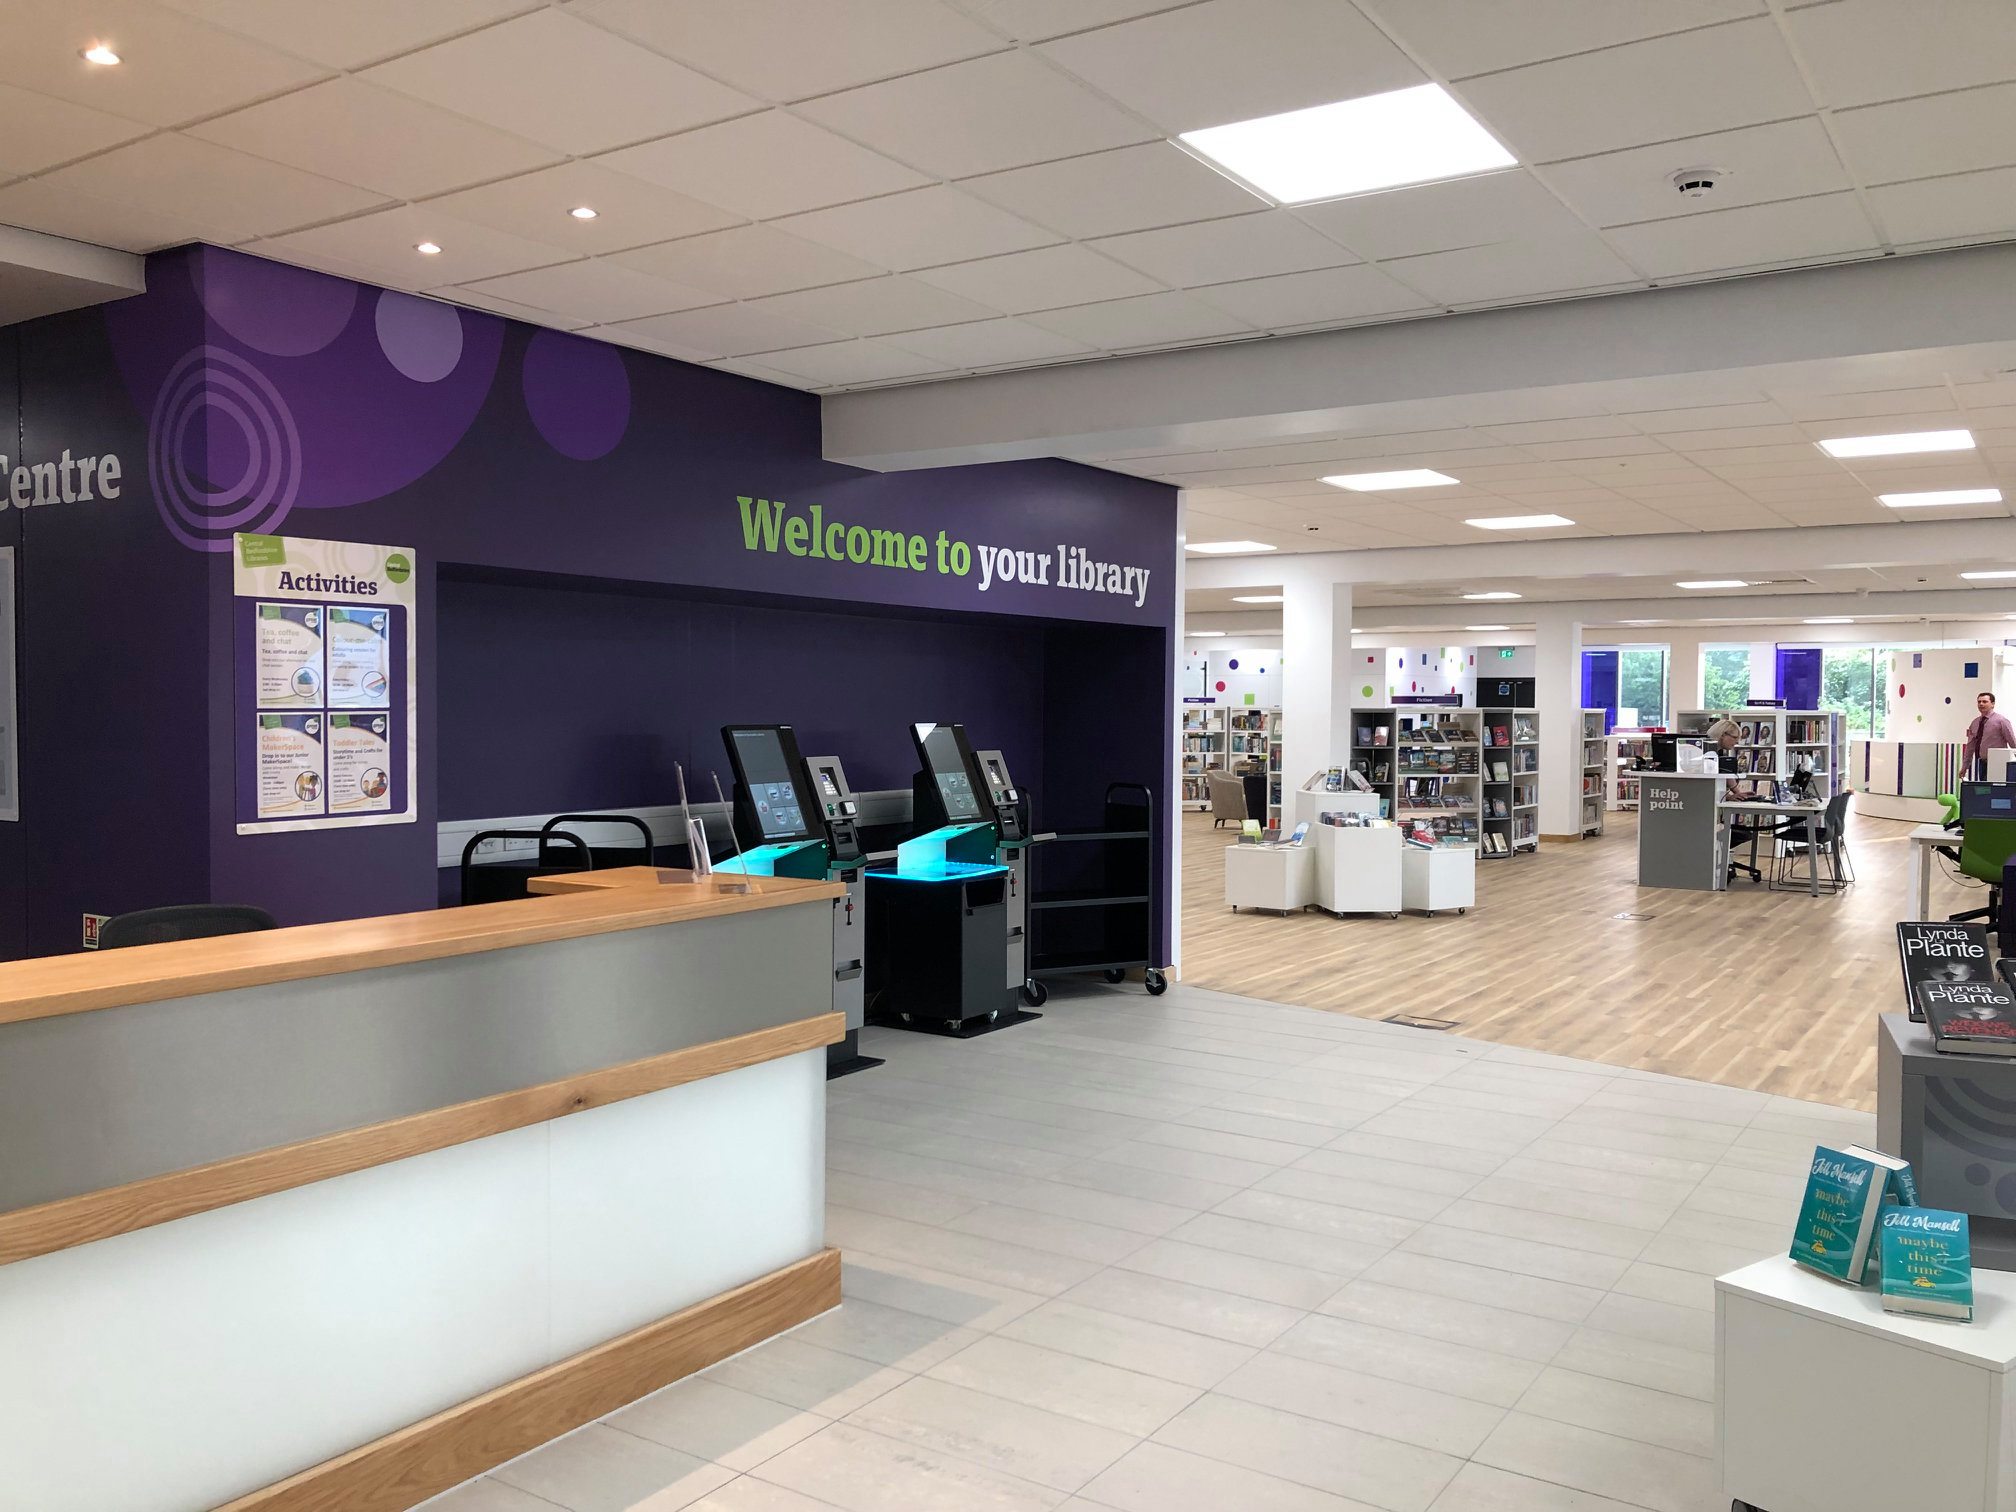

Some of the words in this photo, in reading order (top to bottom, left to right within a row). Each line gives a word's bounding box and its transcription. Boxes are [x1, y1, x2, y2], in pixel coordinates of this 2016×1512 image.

[737, 496, 928, 571] Welcome
[935, 530, 971, 576] to
[977, 545, 1051, 592] your
[1057, 544, 1150, 608] library
[278, 571, 378, 595] Activities
[1650, 788, 1679, 800] Help
[1650, 800, 1684, 810] point
[1917, 927, 1969, 942] Lynda
[1906, 939, 1984, 958] Plante
[1939, 984, 1993, 994] Lynda
[1928, 991, 2010, 1005] Plante
[1812, 1158, 1830, 1176] Jill
[1831, 1162, 1867, 1186] Mansell
[1815, 1188, 1849, 1207] maybe
[1816, 1208, 1836, 1224] this
[1884, 1213, 1910, 1227] Jill
[1912, 1216, 1961, 1232] Mansell
[1812, 1224, 1836, 1241] time
[1898, 1235, 1948, 1250] maybe
[1908, 1250, 1937, 1263] this
[1907, 1264, 1943, 1276] time
